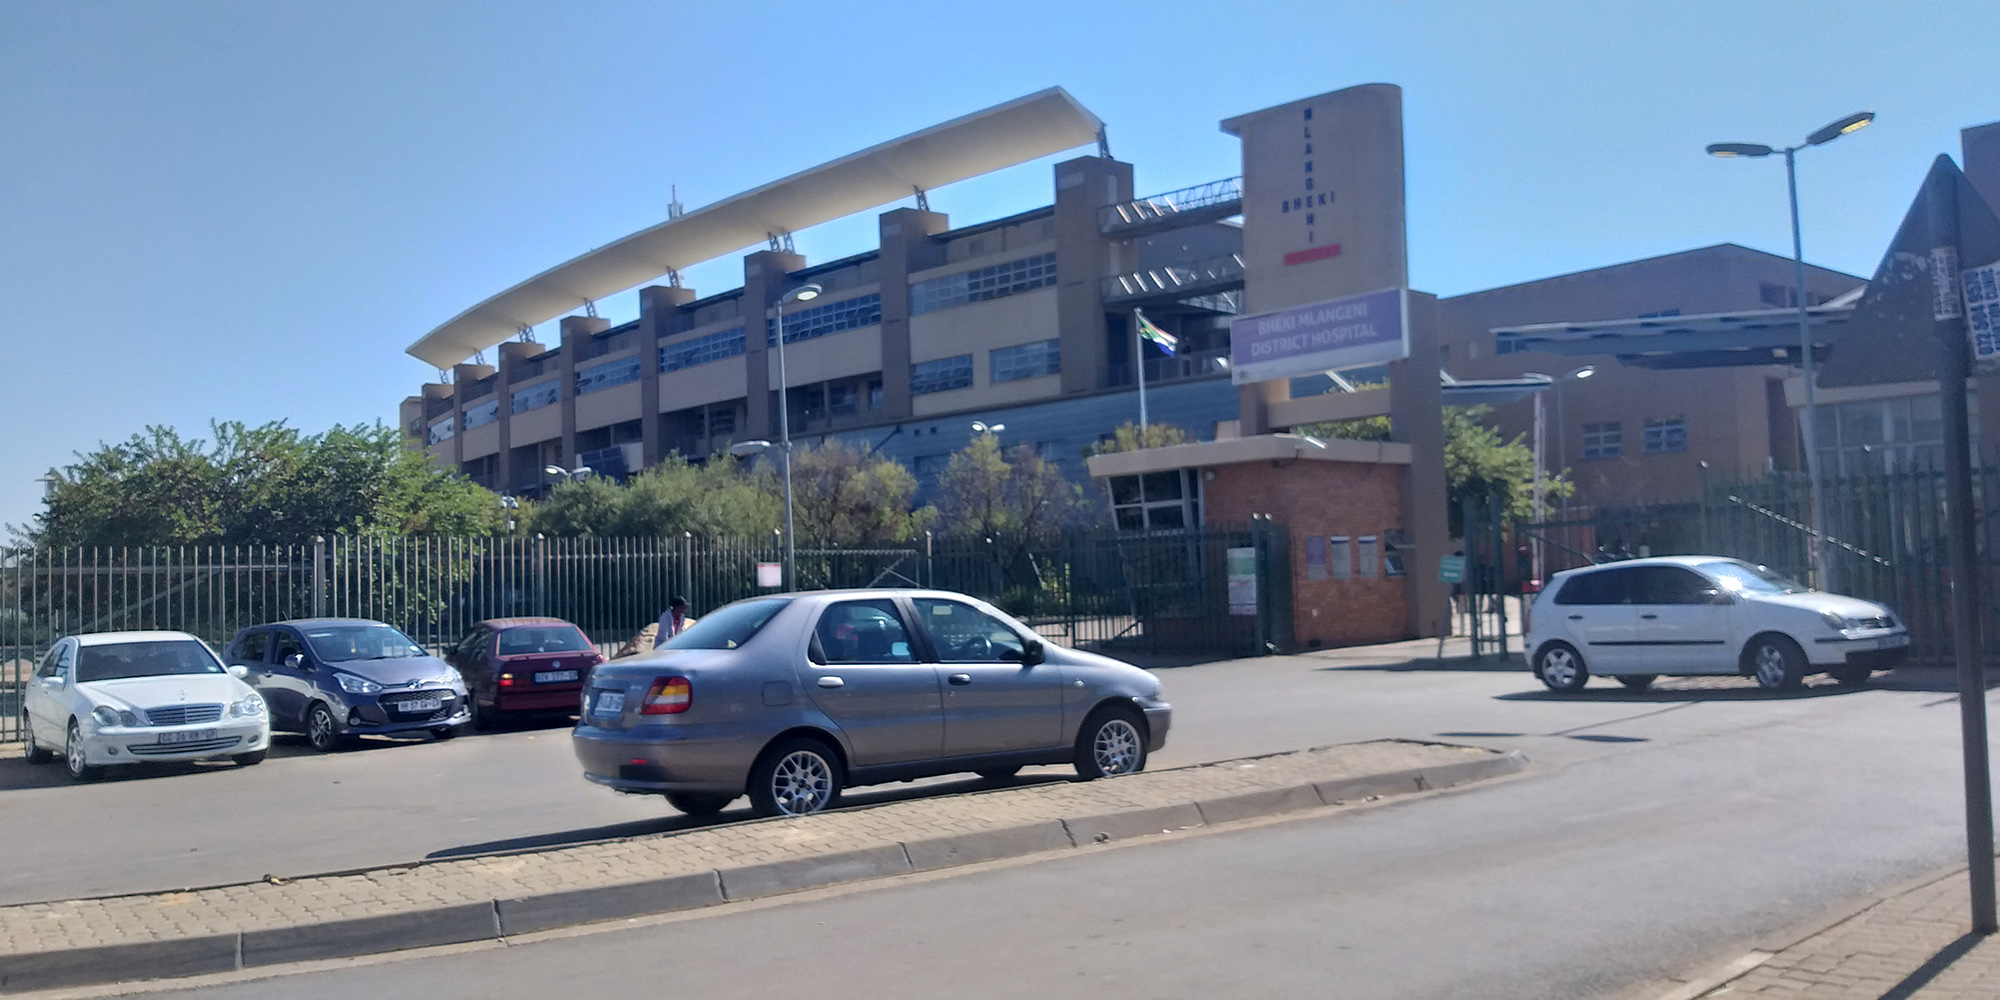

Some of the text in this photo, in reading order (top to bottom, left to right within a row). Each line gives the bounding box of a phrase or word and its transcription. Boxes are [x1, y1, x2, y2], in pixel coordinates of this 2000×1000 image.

[1258, 301, 1368, 336] BHEKI MLANGENI
[1251, 323, 1377, 357] DISTRICT HOSPITAL
